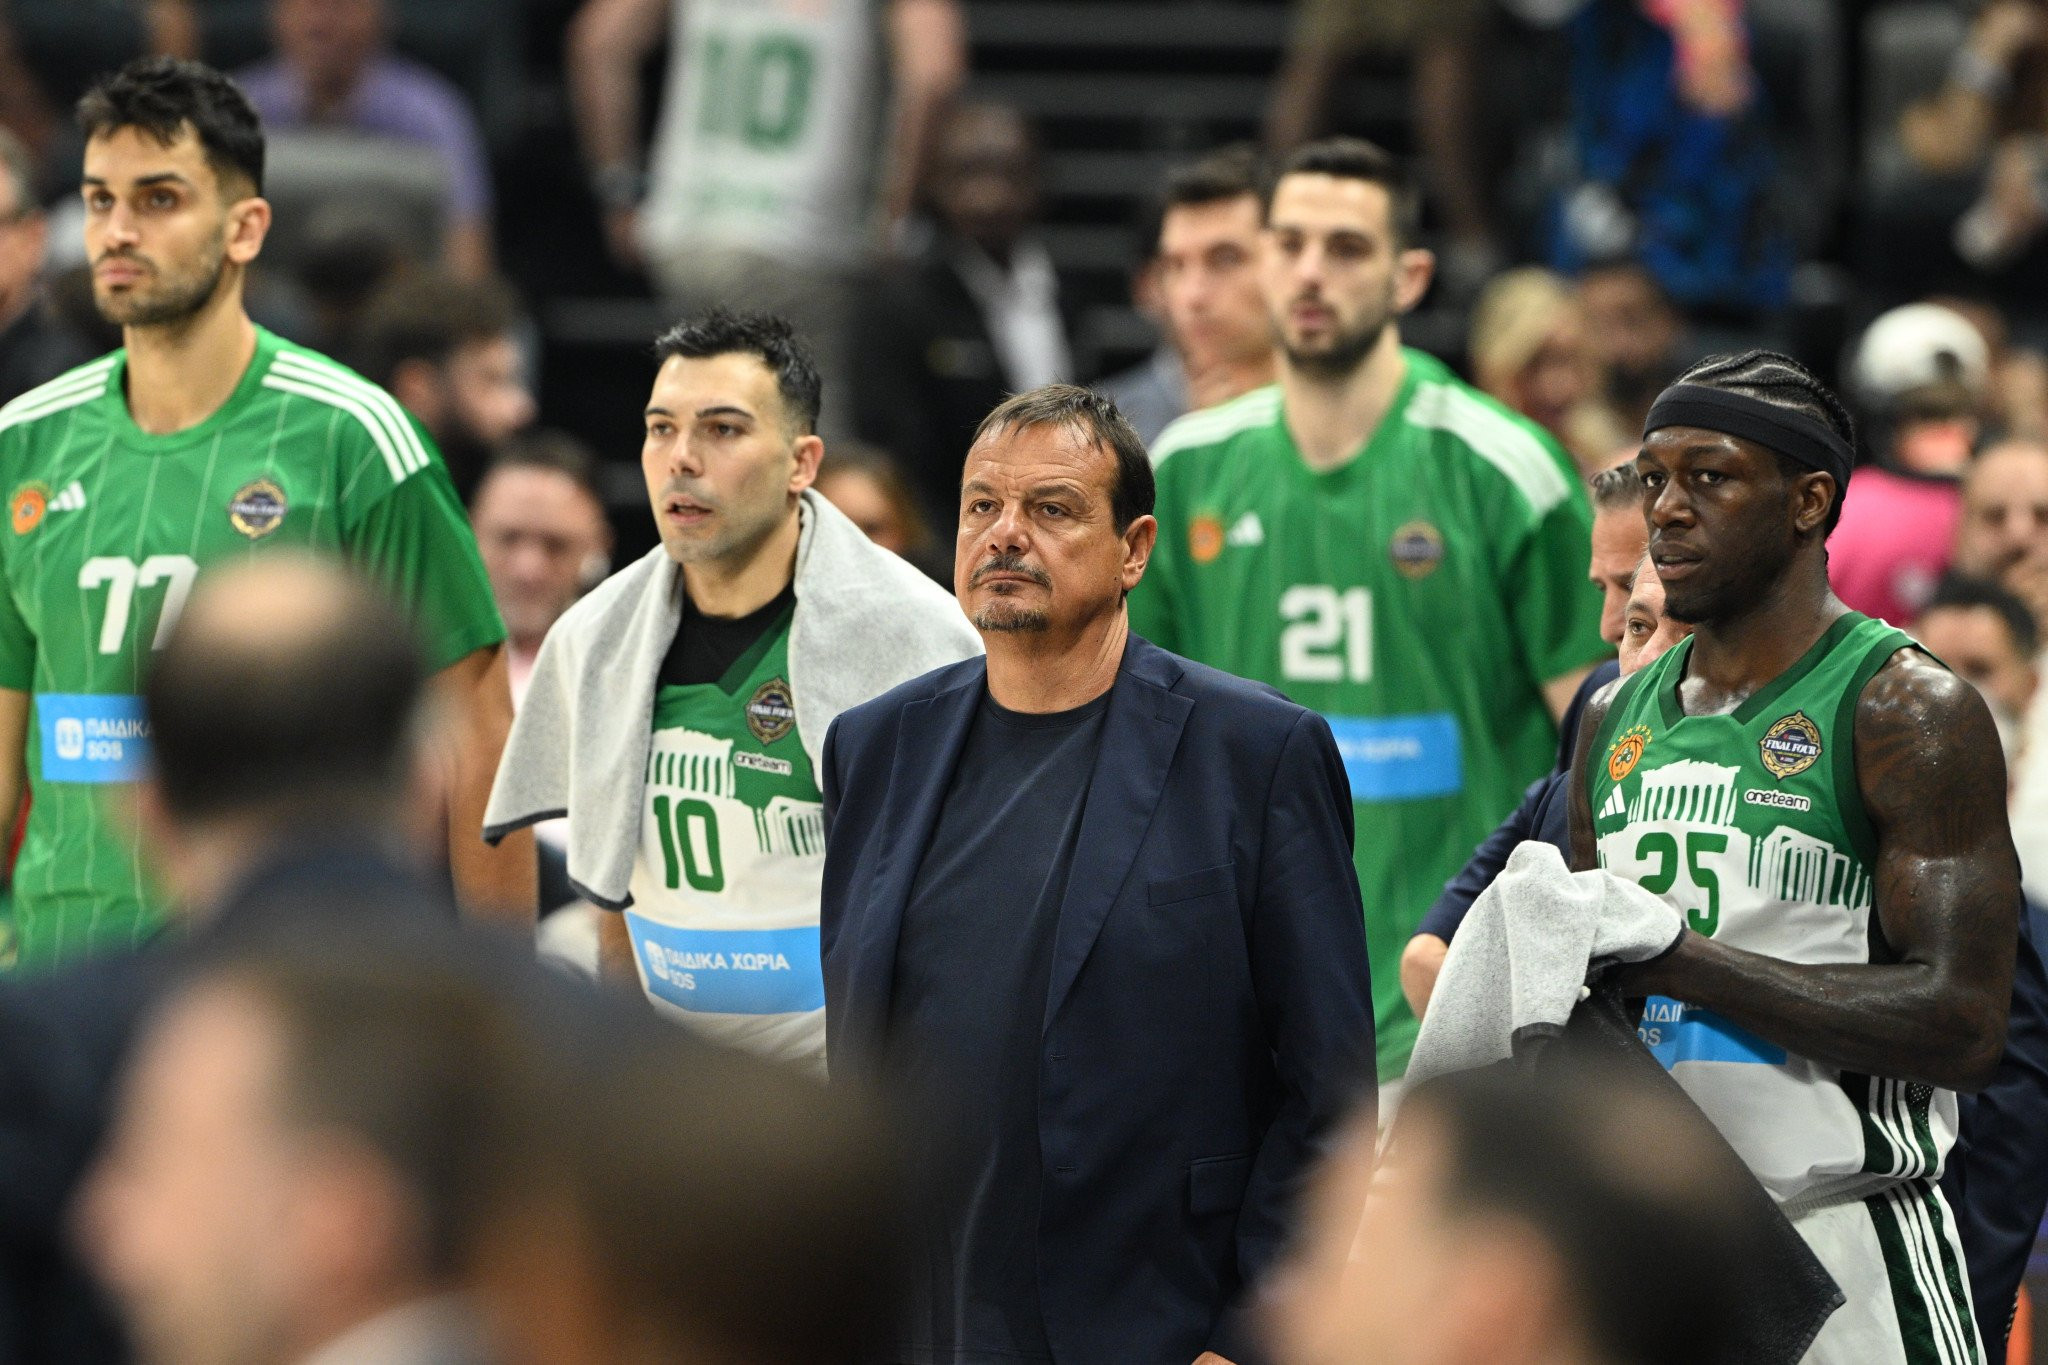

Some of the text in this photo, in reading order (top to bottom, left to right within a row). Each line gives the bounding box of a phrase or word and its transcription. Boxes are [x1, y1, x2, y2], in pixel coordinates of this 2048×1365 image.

[700, 27, 814, 151] 10
[78, 554, 199, 655] 77
[1279, 585, 1374, 684] 21
[1765, 739, 1790, 752] FINAL
[1792, 743, 1817, 755] FOUR
[653, 795, 725, 893] 10
[1746, 791, 1809, 809] oneteam
[1636, 831, 1728, 938] 25
[731, 953, 791, 971] ΧΩΡΙΑ
[1637, 1027, 1661, 1047] OS
